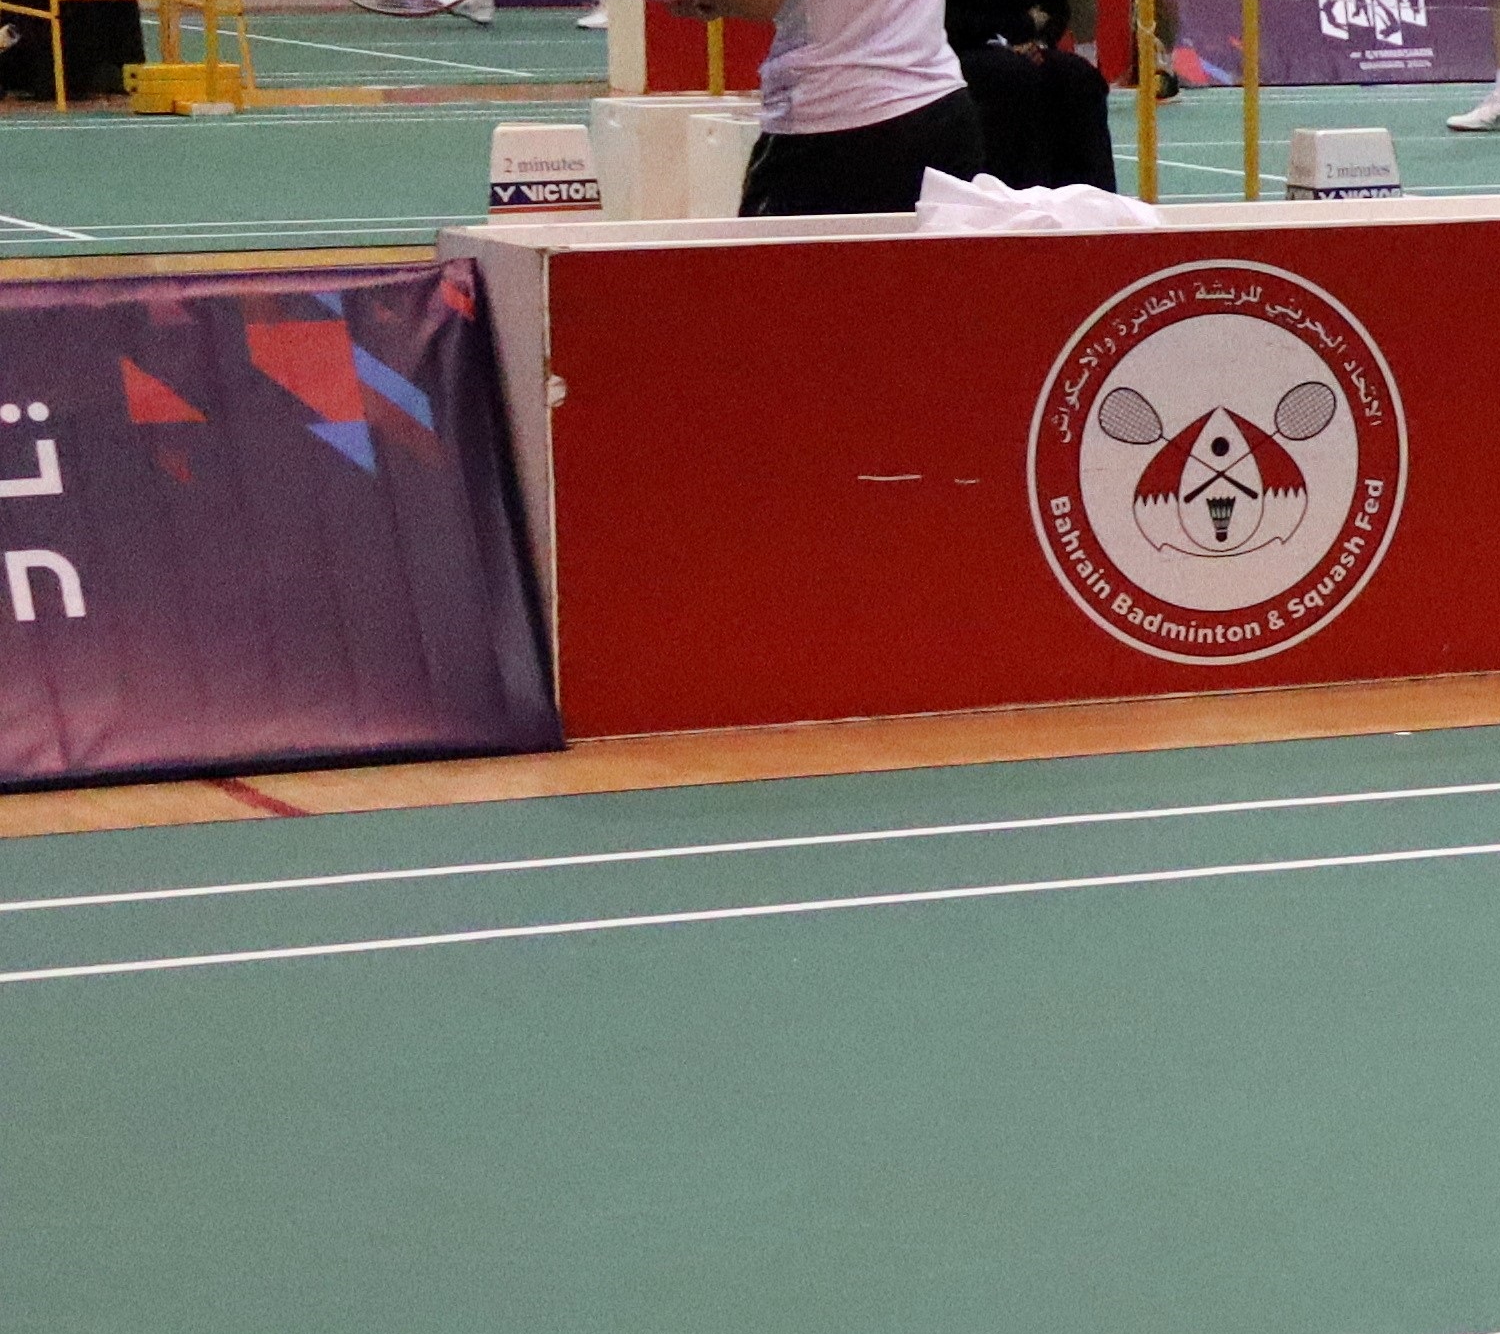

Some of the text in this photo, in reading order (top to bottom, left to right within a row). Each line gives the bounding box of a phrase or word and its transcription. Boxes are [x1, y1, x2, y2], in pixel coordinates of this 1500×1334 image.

[503, 156, 586, 173] 2 minutes
[519, 181, 599, 202] VICTOR
[1050, 478, 1385, 644] Bahrain Badminton & Squash Fed
